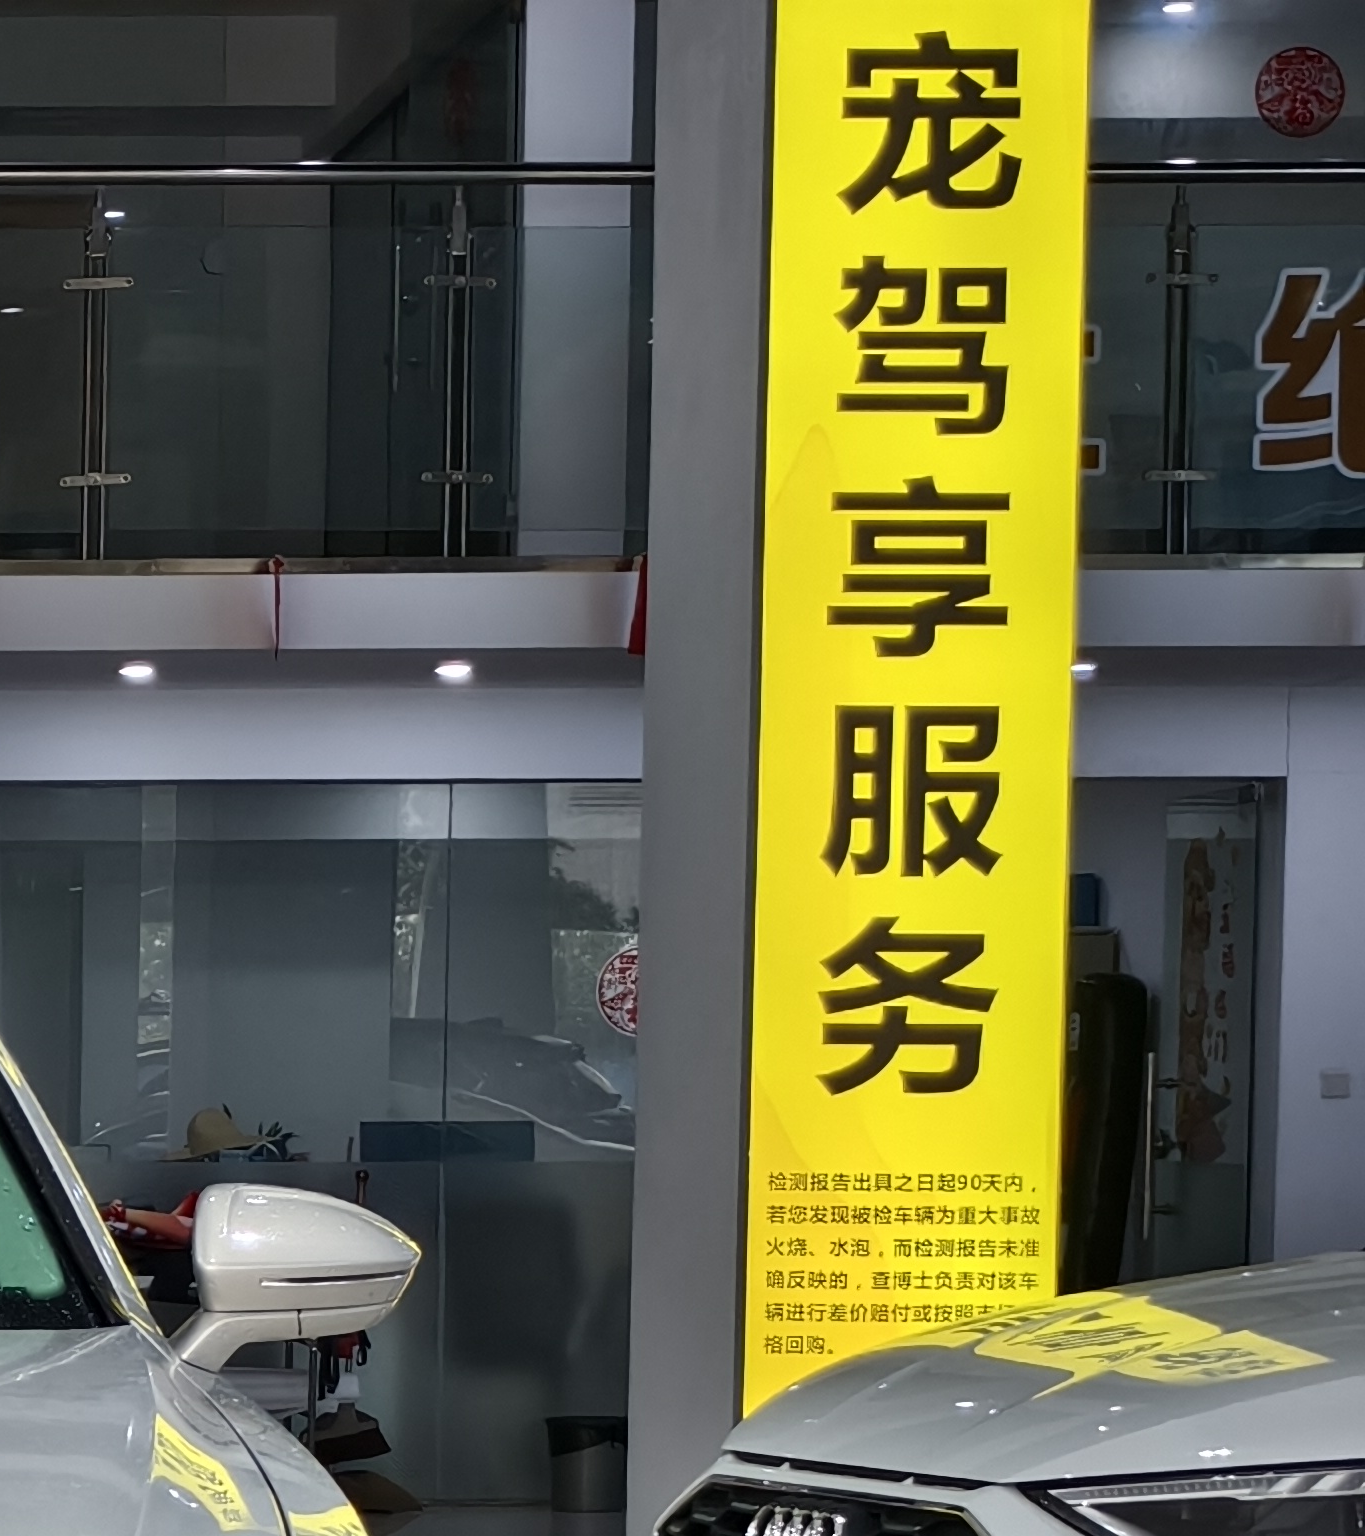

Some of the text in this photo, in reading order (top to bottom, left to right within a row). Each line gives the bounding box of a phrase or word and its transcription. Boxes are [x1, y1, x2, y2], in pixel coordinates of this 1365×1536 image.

[816, 30, 1022, 1096] 宠驾享服务
